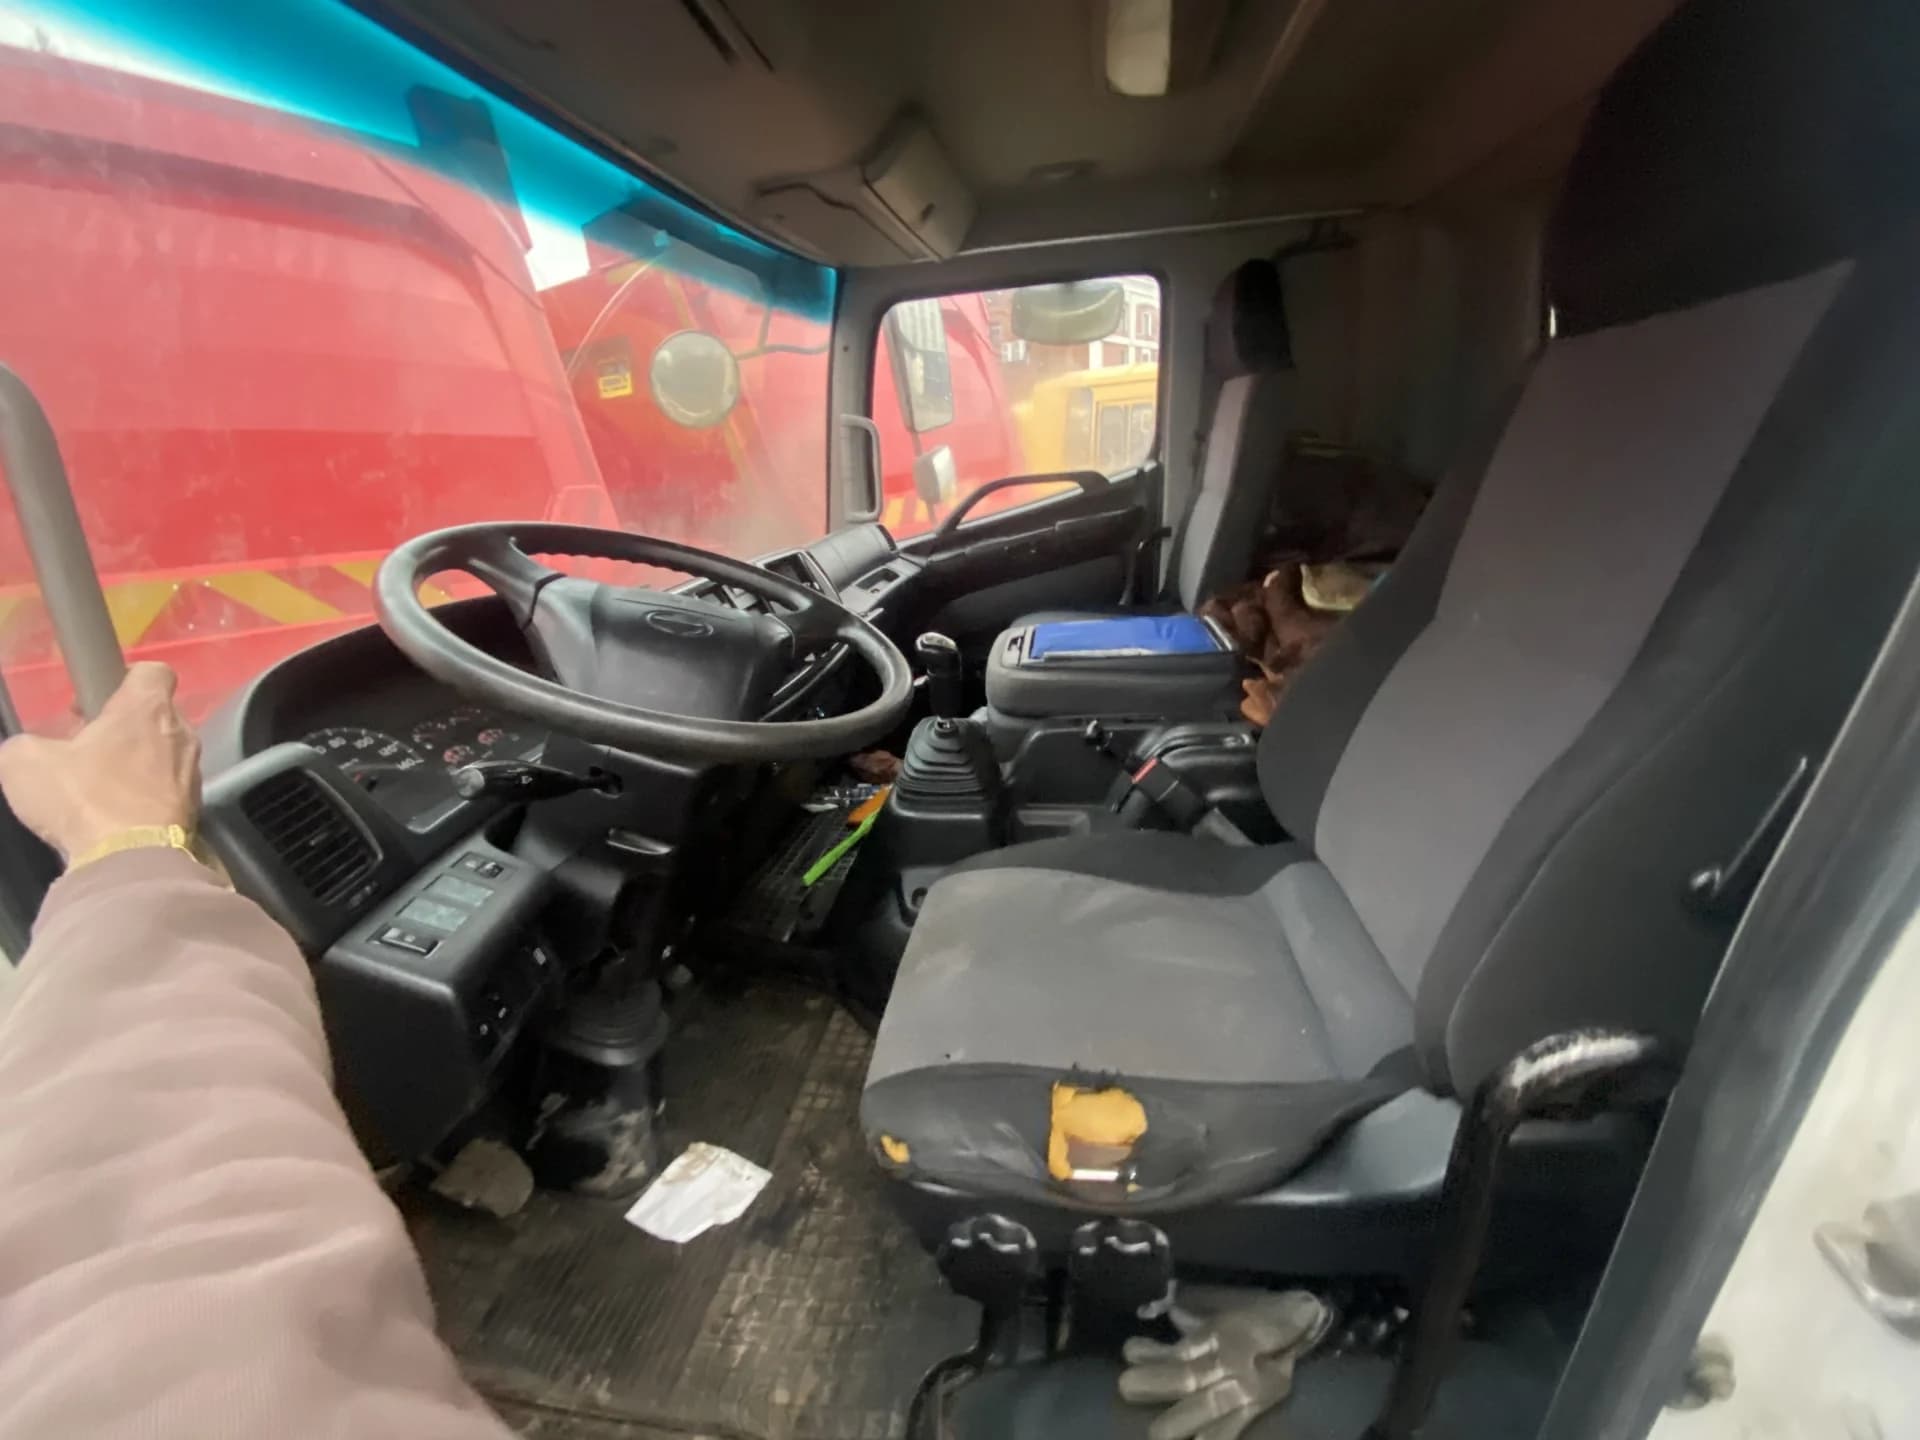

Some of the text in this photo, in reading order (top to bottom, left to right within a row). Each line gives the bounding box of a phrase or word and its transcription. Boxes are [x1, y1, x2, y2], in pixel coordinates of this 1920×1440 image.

[328, 736, 346, 749] 80
[353, 736, 374, 749] 100
[378, 743, 398, 756] 120
[395, 758, 416, 770] 140
